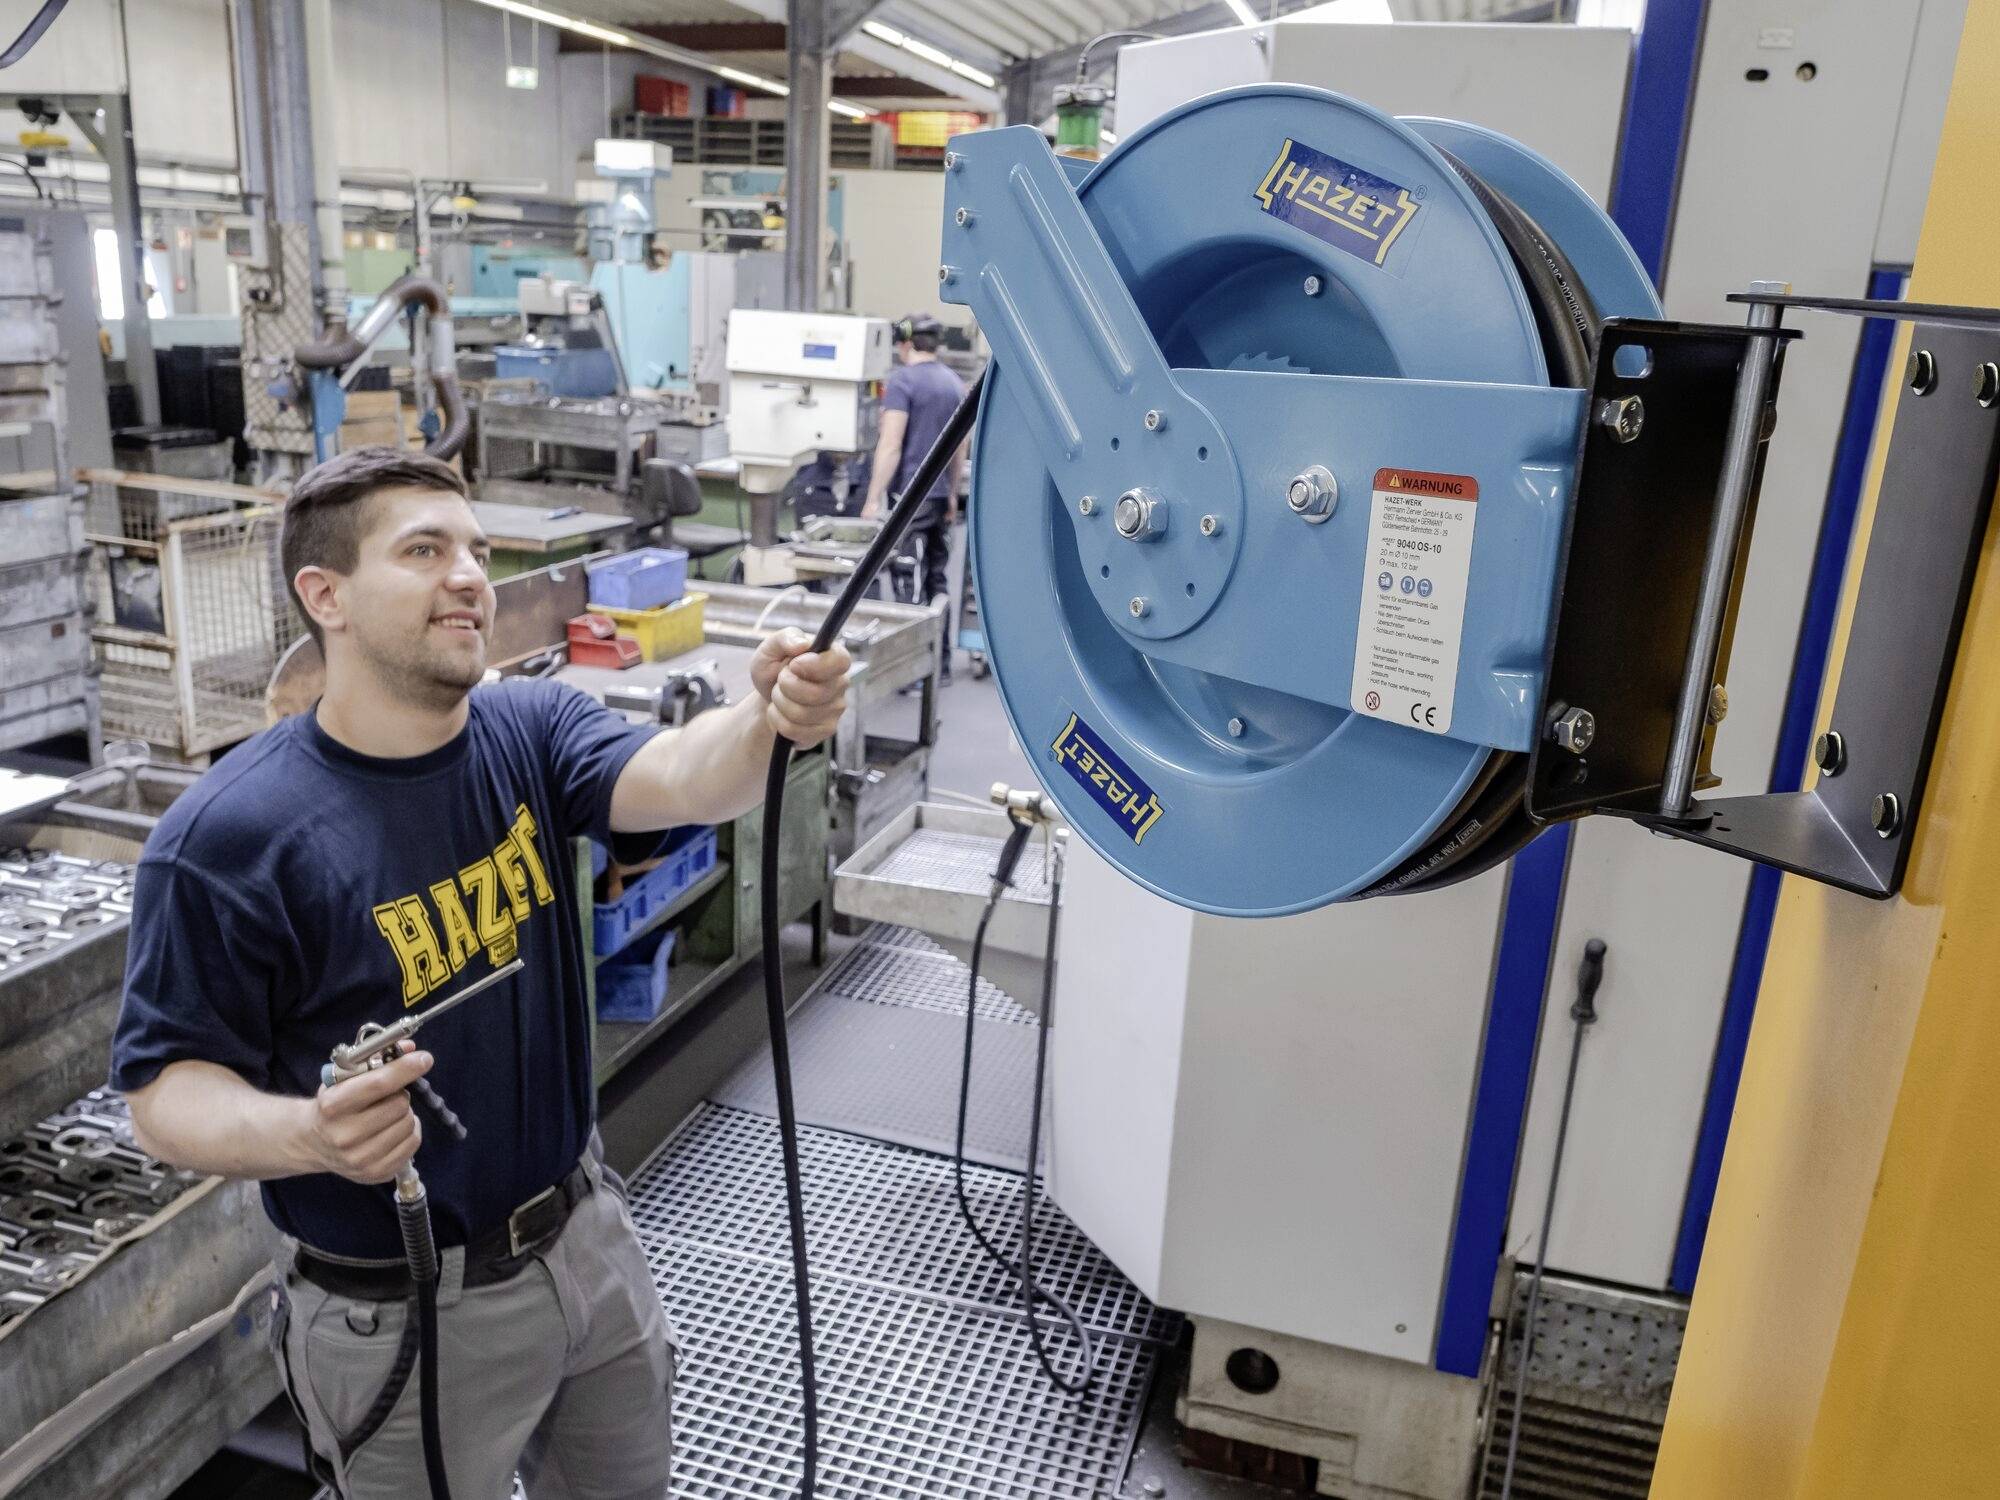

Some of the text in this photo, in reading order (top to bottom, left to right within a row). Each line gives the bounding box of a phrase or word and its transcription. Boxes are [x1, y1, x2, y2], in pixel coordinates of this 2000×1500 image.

[1273, 161, 1396, 230] HAZET
[1402, 477, 1462, 494] WARNUNG
[1385, 496, 1422, 506] HAZET-WERK
[1421, 518, 1443, 526] GERMANY
[1423, 509, 1439, 518] GmbH
[1455, 513, 1462, 521] KG
[1397, 539, 1442, 553] 9040 OS-10
[1409, 563, 1418, 572] bar
[1063, 742, 1150, 825] HAZET
[1441, 841, 1458, 857] 20M
[1398, 863, 1429, 885] HYBRID
[372, 803, 555, 1008] HAZET
